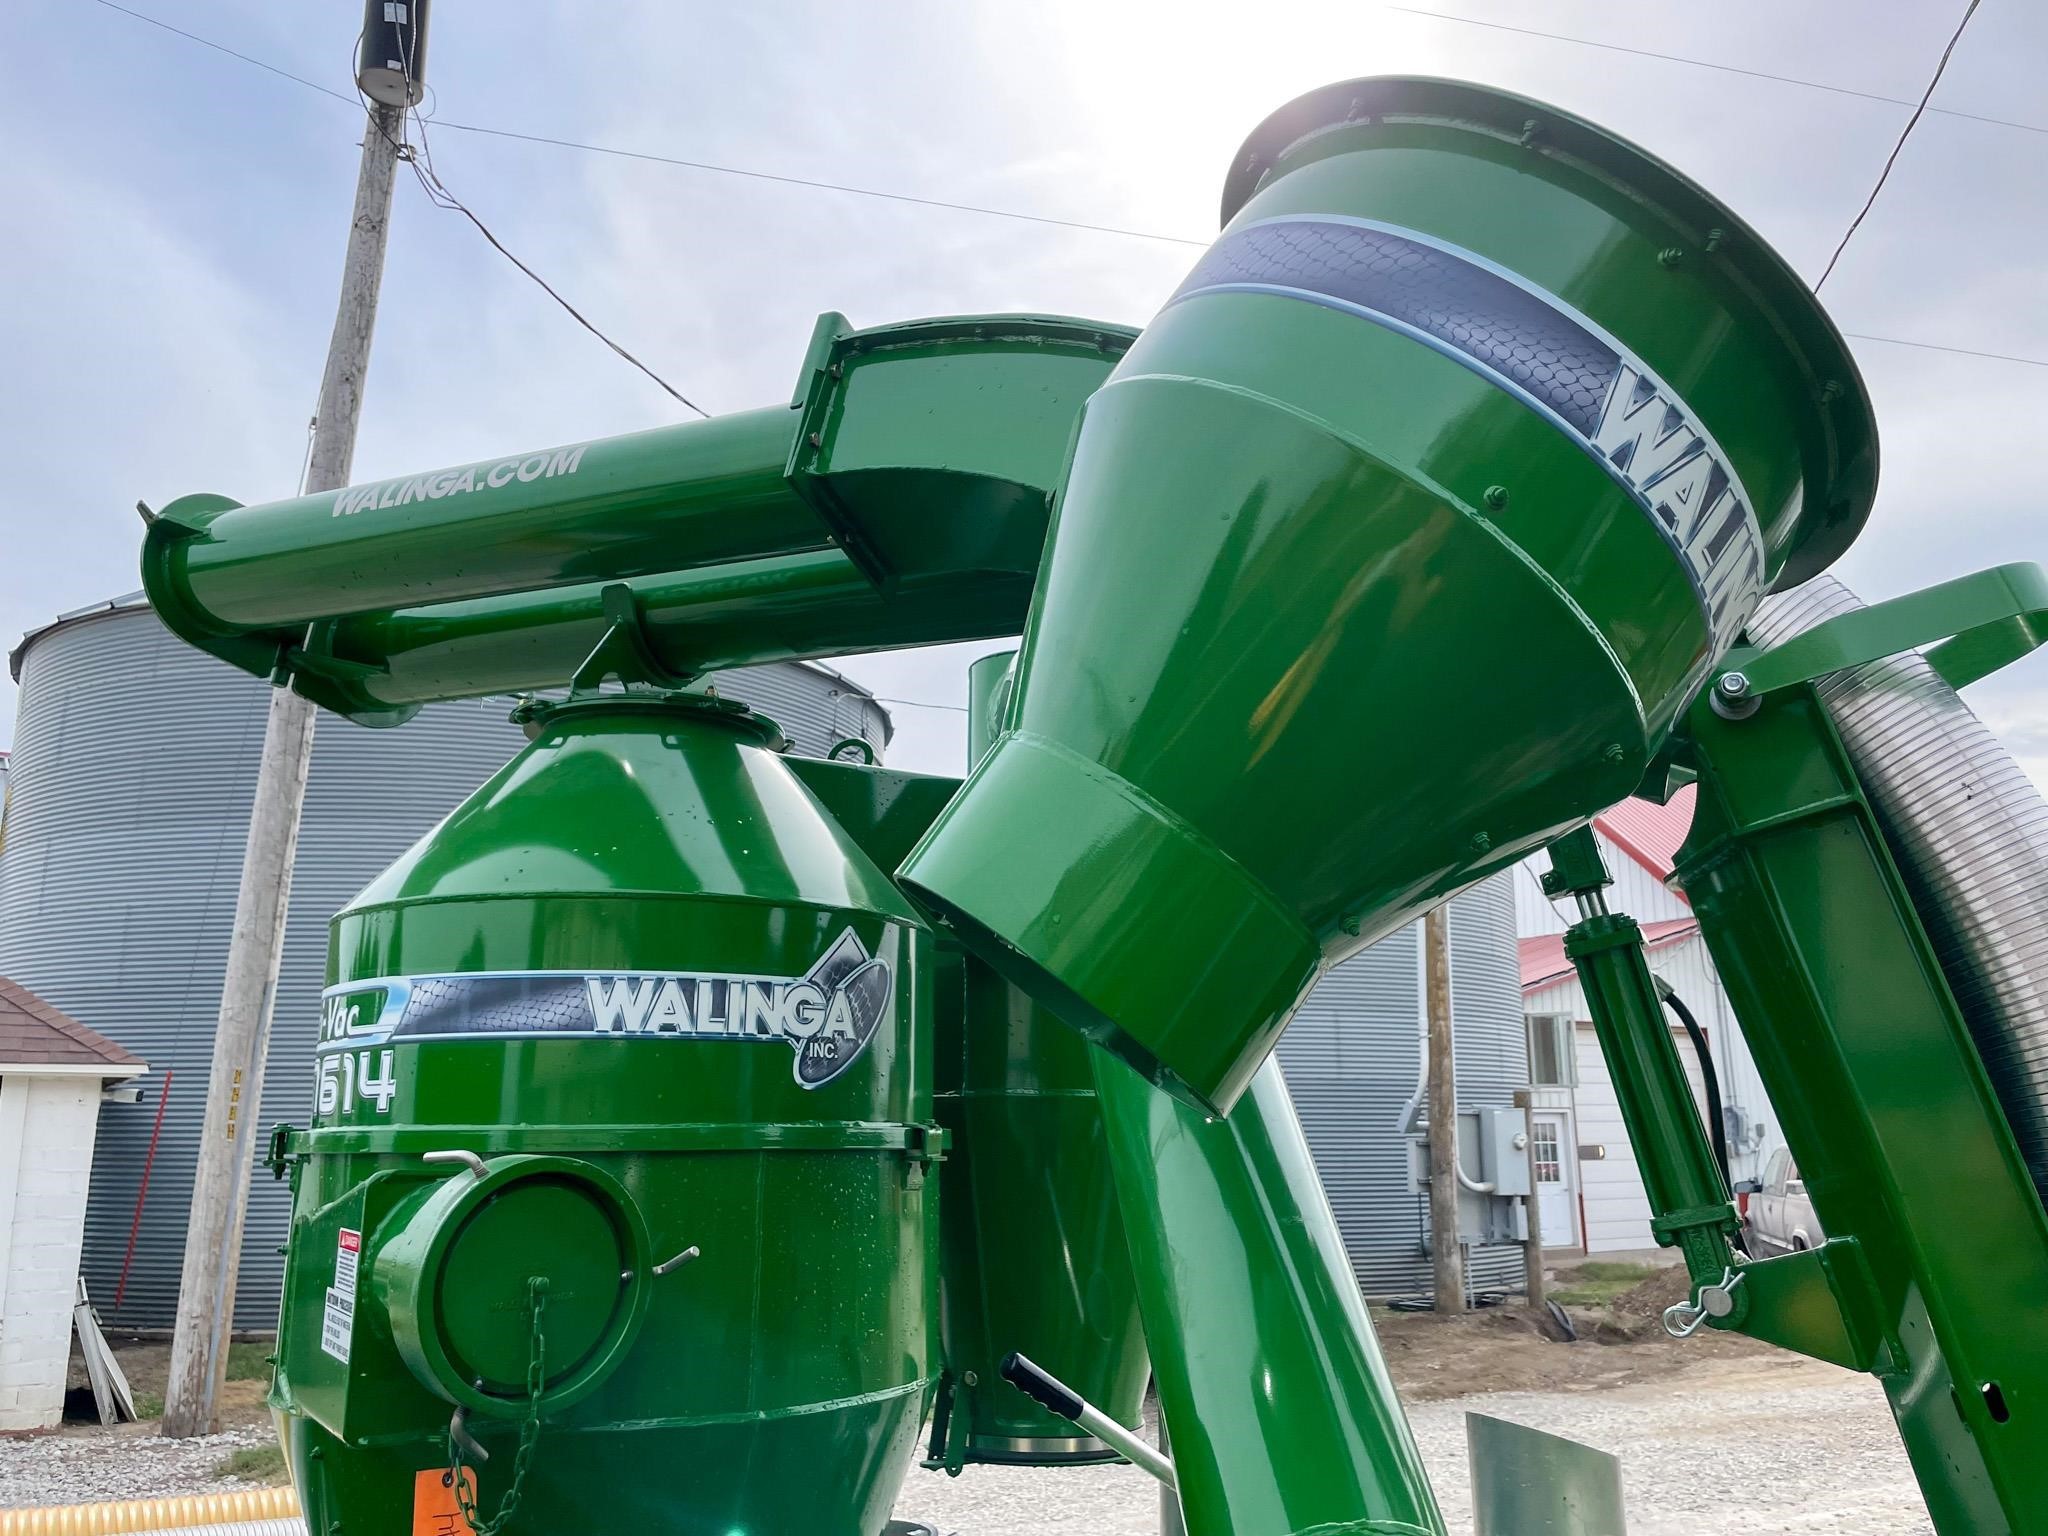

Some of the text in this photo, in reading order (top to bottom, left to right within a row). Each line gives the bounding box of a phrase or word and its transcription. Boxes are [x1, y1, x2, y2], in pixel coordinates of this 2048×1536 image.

[332, 447, 588, 517] WALINGA.COM
[584, 977, 857, 1041] WALINGA
[809, 1043, 838, 1059] INC.
